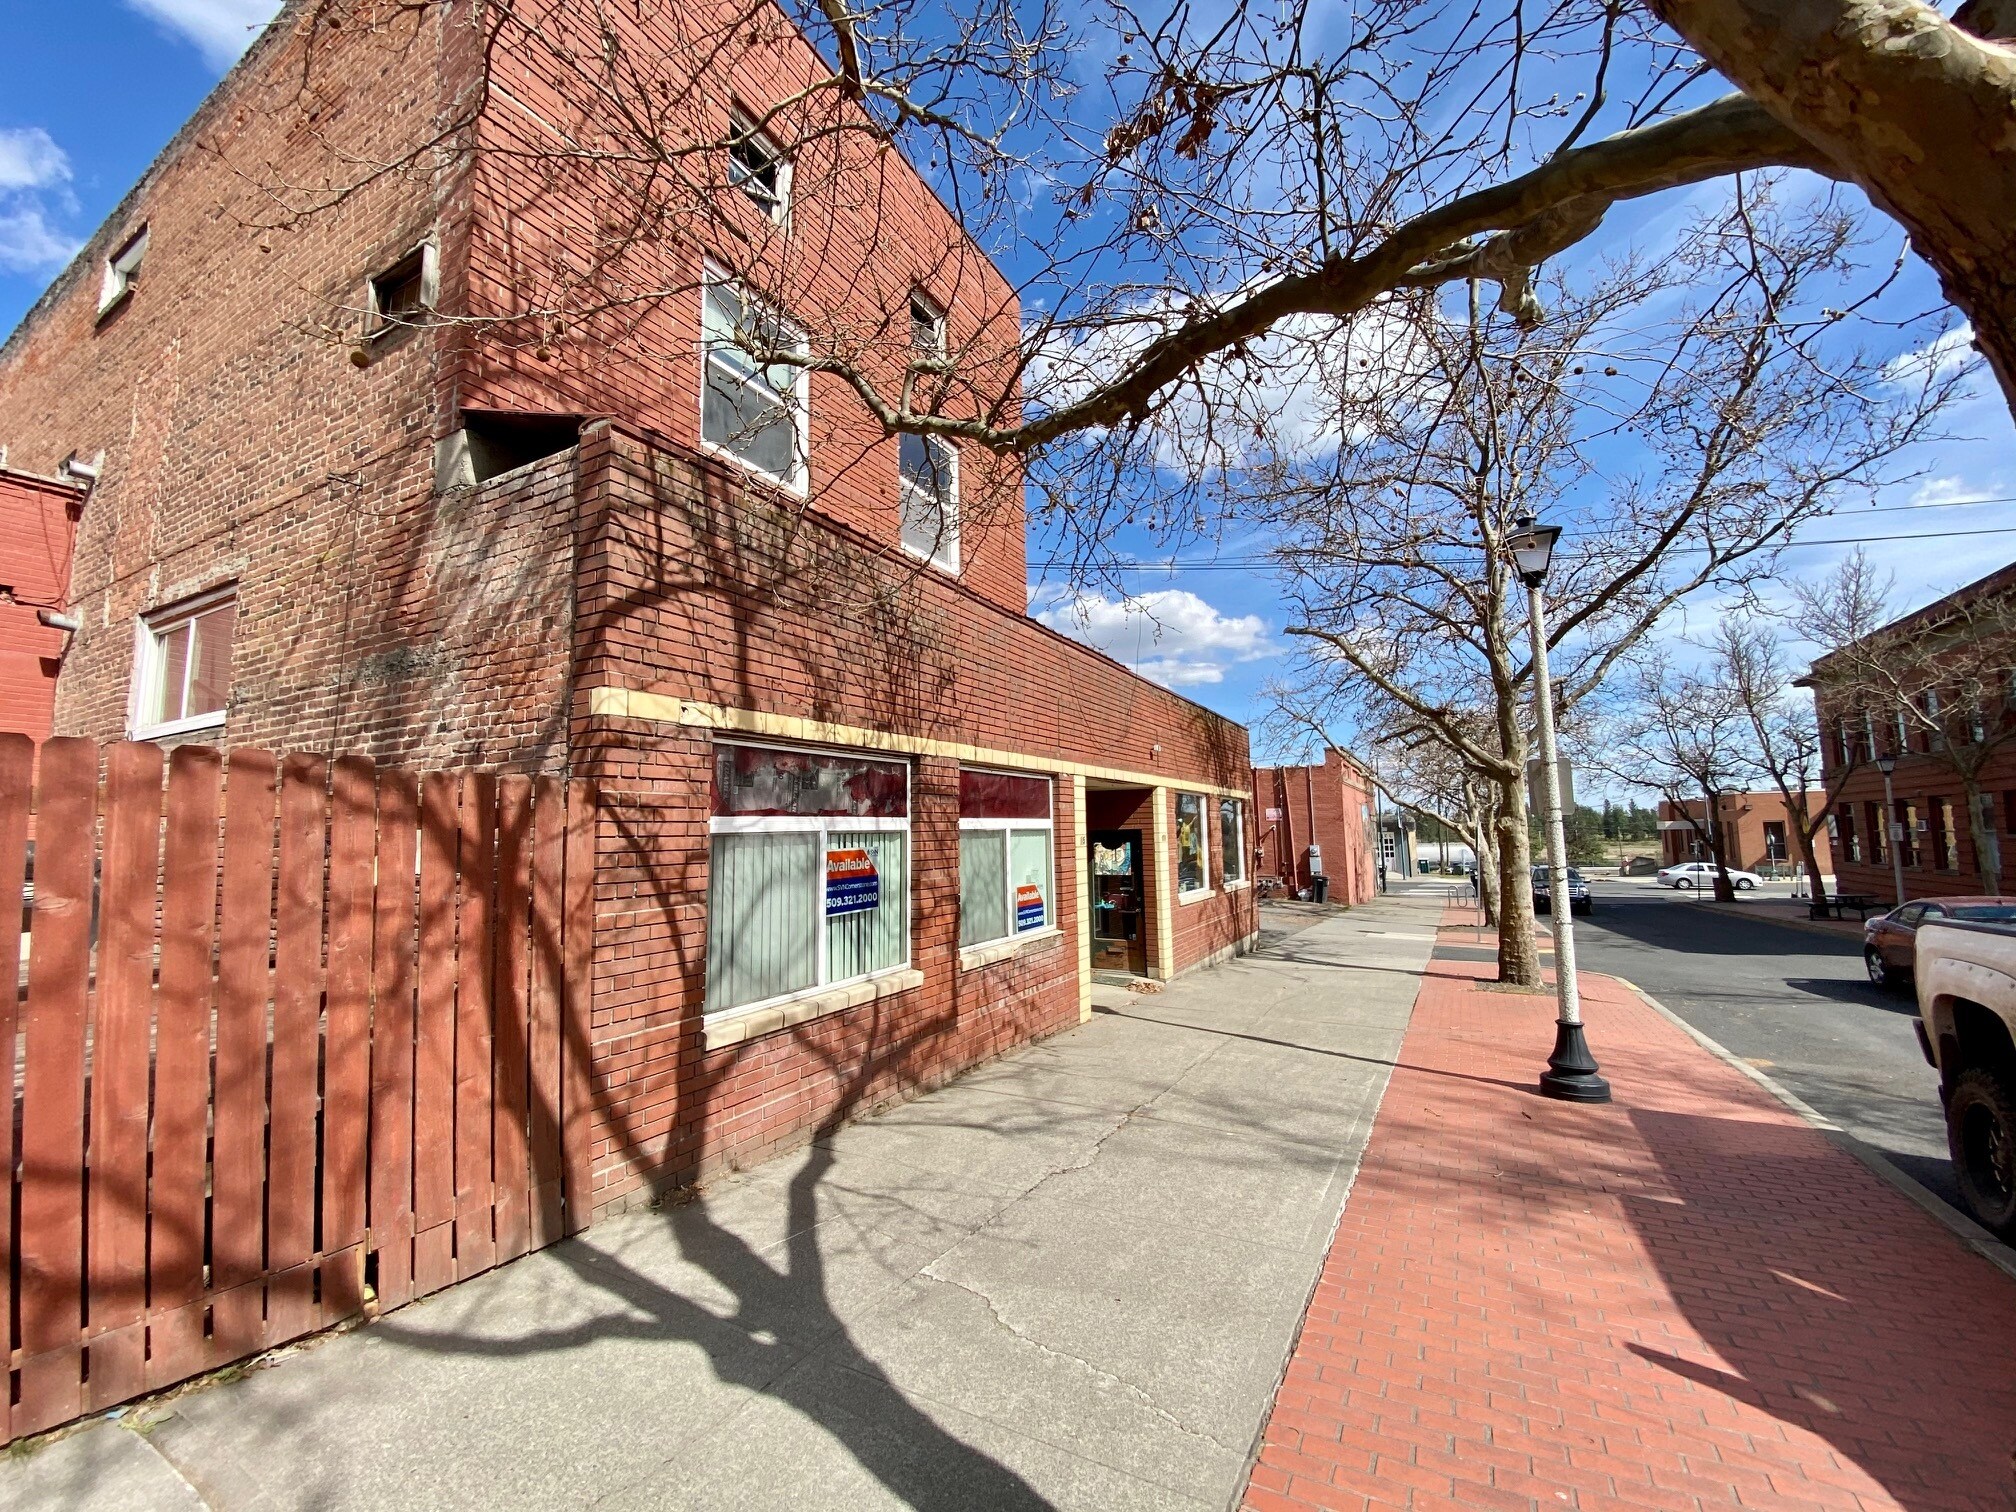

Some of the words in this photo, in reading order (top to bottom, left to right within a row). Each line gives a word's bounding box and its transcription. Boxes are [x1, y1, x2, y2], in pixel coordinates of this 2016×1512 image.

[827, 857, 870, 872] Available
[826, 892, 877, 908] 509.321.2000
[1018, 890, 1039, 902] Available
